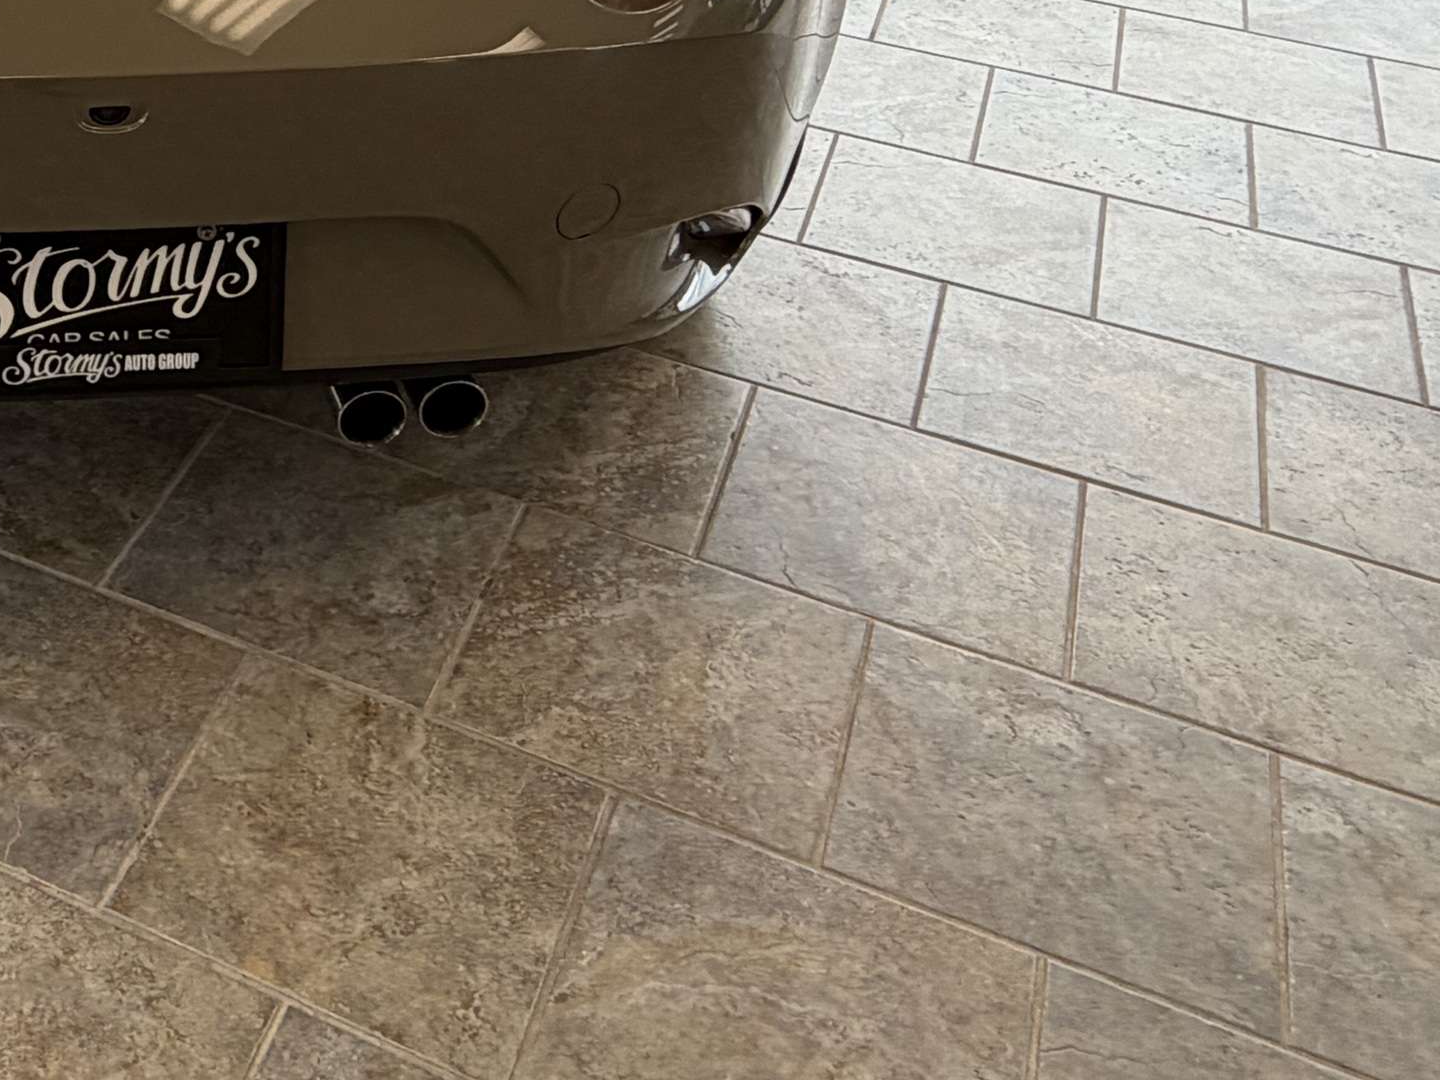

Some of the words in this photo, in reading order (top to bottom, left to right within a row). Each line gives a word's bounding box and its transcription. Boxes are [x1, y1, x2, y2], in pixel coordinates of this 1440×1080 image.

[1, 346, 123, 386] Stormy's
[124, 353, 156, 372] AUTO
[158, 351, 201, 371] GROUP
